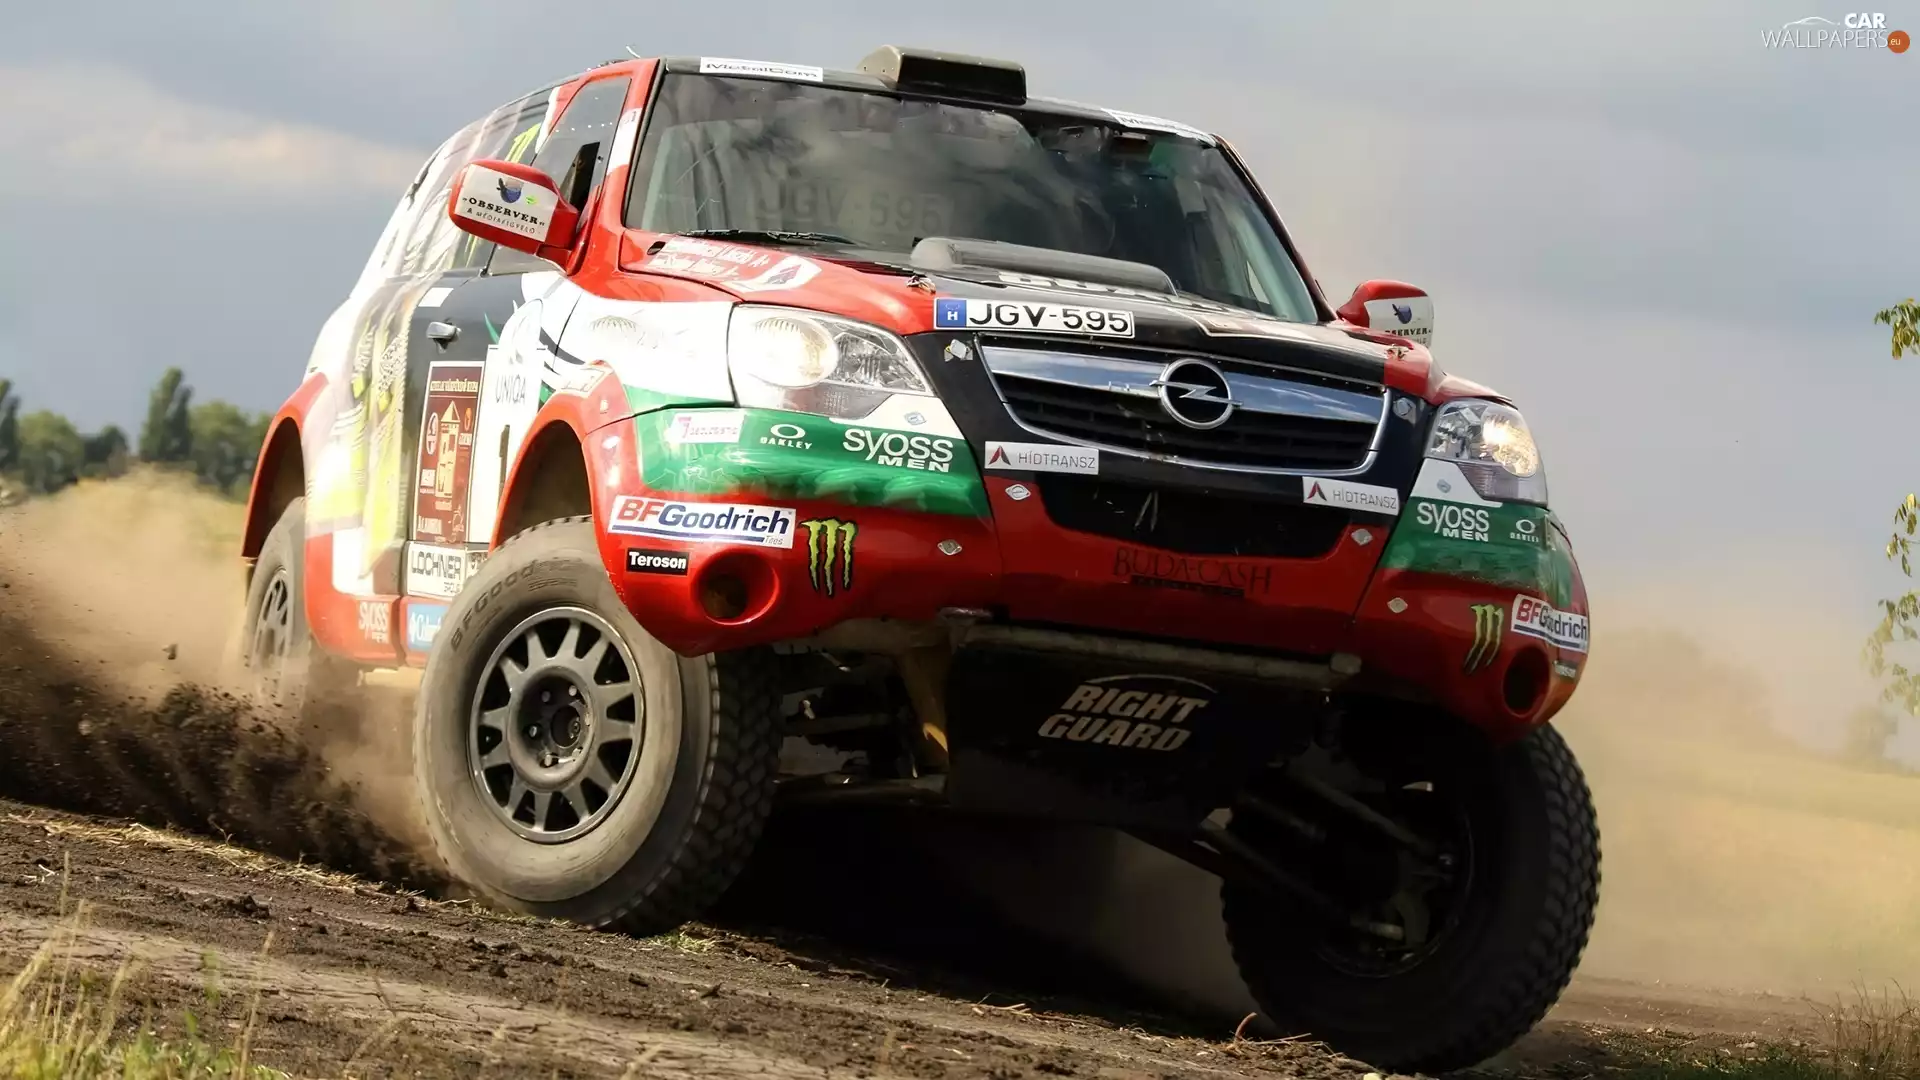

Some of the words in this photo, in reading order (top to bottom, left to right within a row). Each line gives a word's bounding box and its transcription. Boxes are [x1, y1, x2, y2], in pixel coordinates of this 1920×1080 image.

[947, 310, 959, 322] H
[969, 303, 1129, 333] JGV-595
[494, 375, 527, 405] UNIQA
[760, 436, 812, 450] OAKLEY
[877, 454, 950, 473] MEN
[616, 497, 791, 535] BFGoodrich
[1442, 527, 1489, 542] MEN
[411, 551, 462, 580] LOCHNER
[628, 551, 687, 570] Teroson
[1114, 546, 1272, 595] BUDA-CASH
[1059, 683, 1210, 723] RIGHT
[1037, 712, 1193, 752] GUARD
